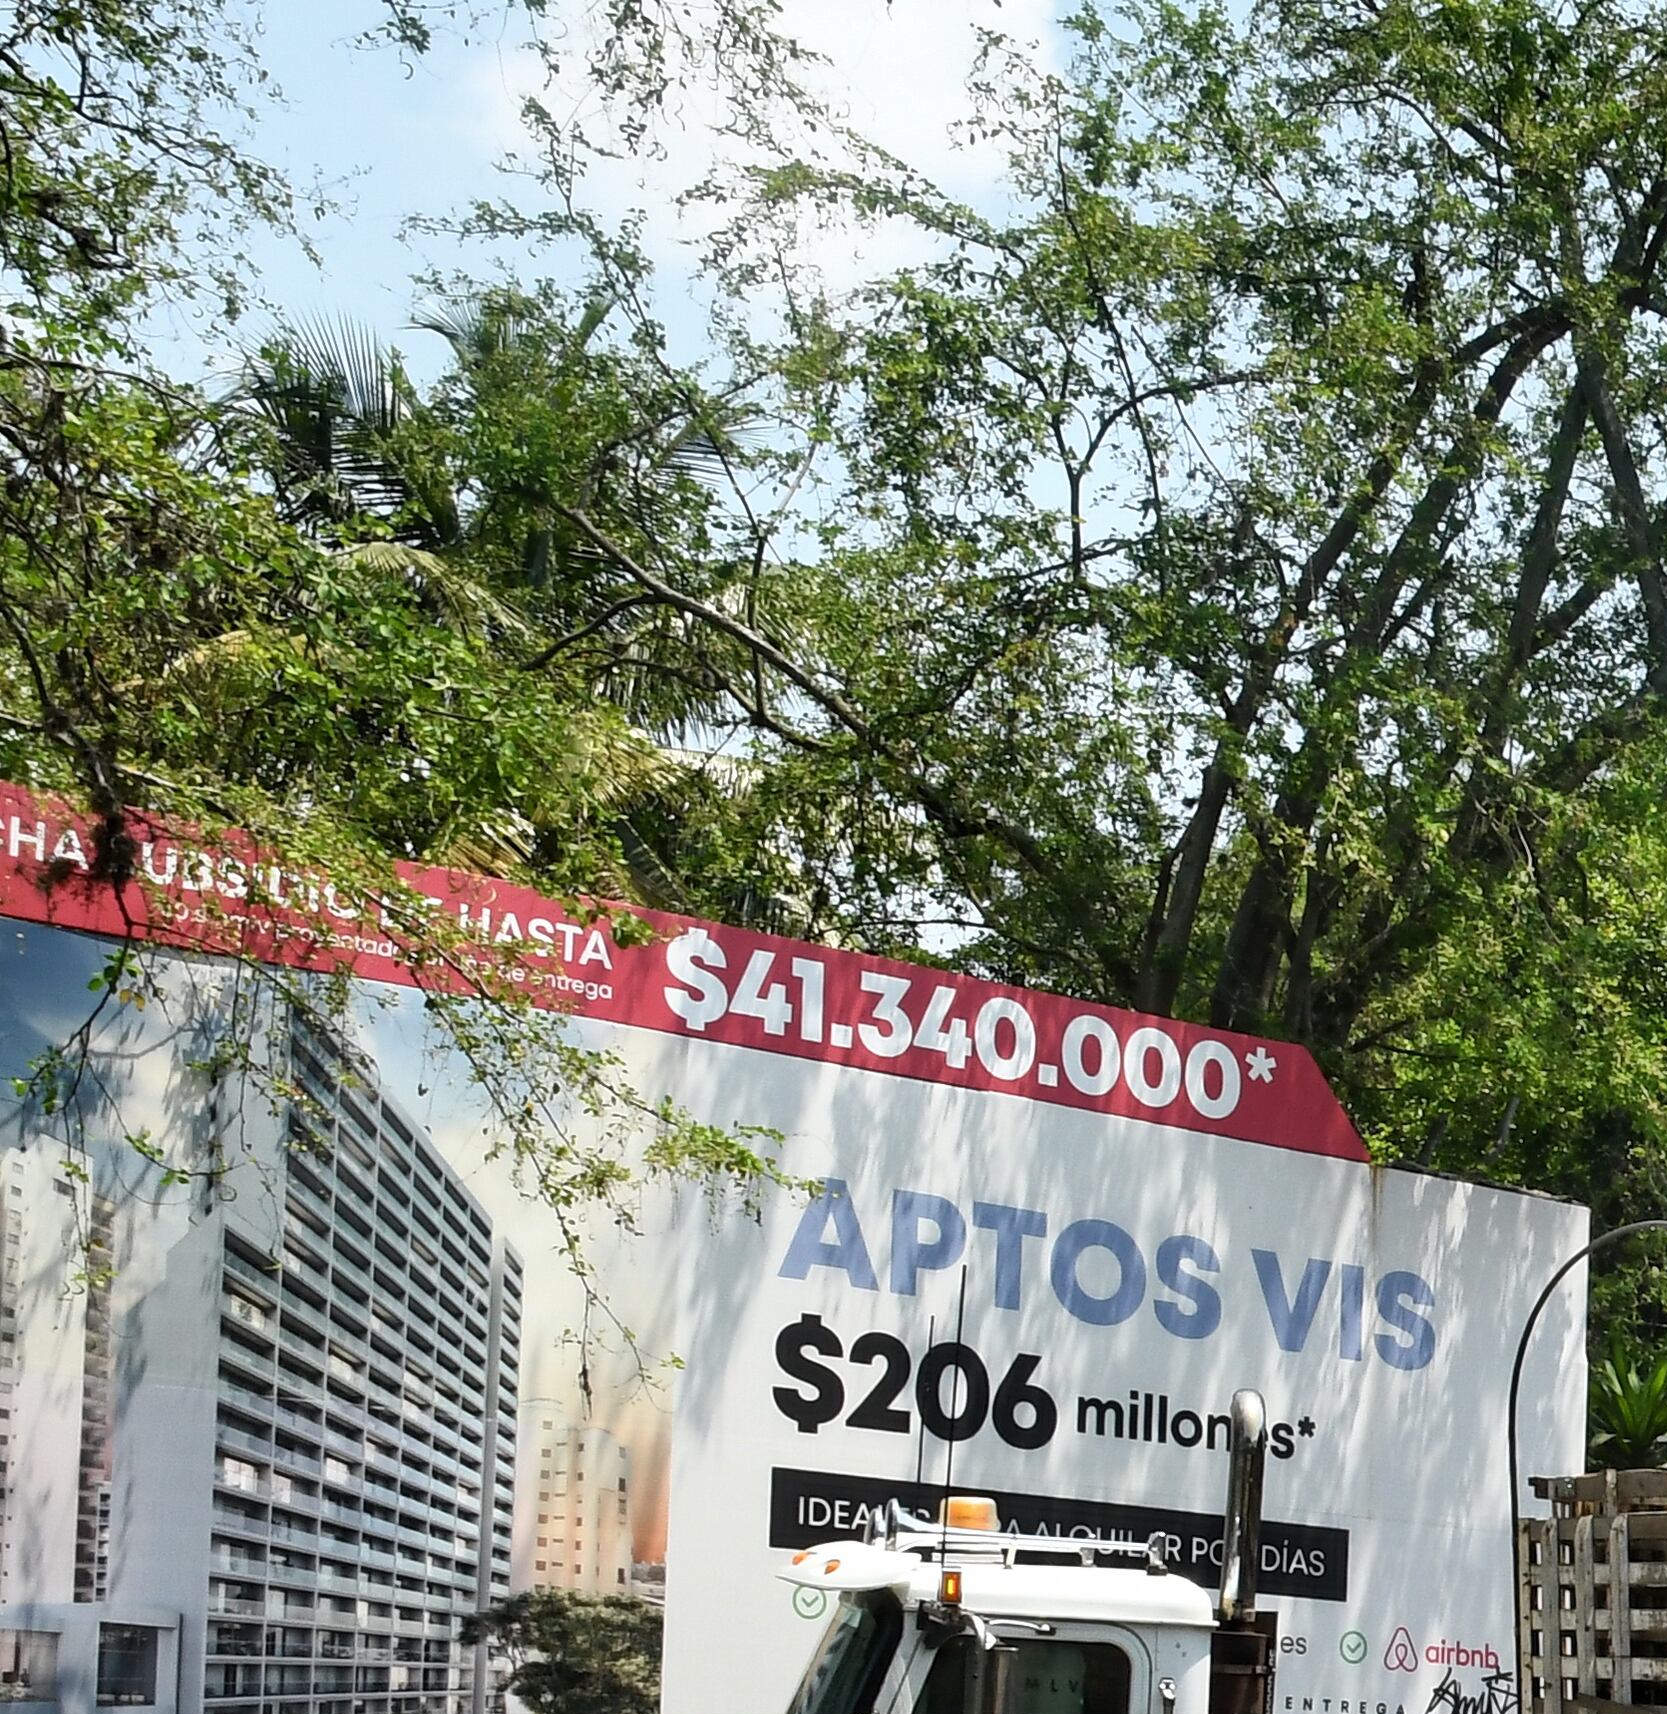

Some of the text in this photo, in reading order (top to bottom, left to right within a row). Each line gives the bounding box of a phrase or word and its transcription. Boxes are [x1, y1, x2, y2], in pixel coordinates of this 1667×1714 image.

[459, 903, 613, 970] HASTA
[777, 1177, 1437, 1371] APTOS VIS
[771, 1312, 1317, 1460] $206 millons
[1261, 1539, 1326, 1577] DÍAS
[1280, 1636, 1308, 1655] es
[1425, 1639, 1499, 1669] airbnb
